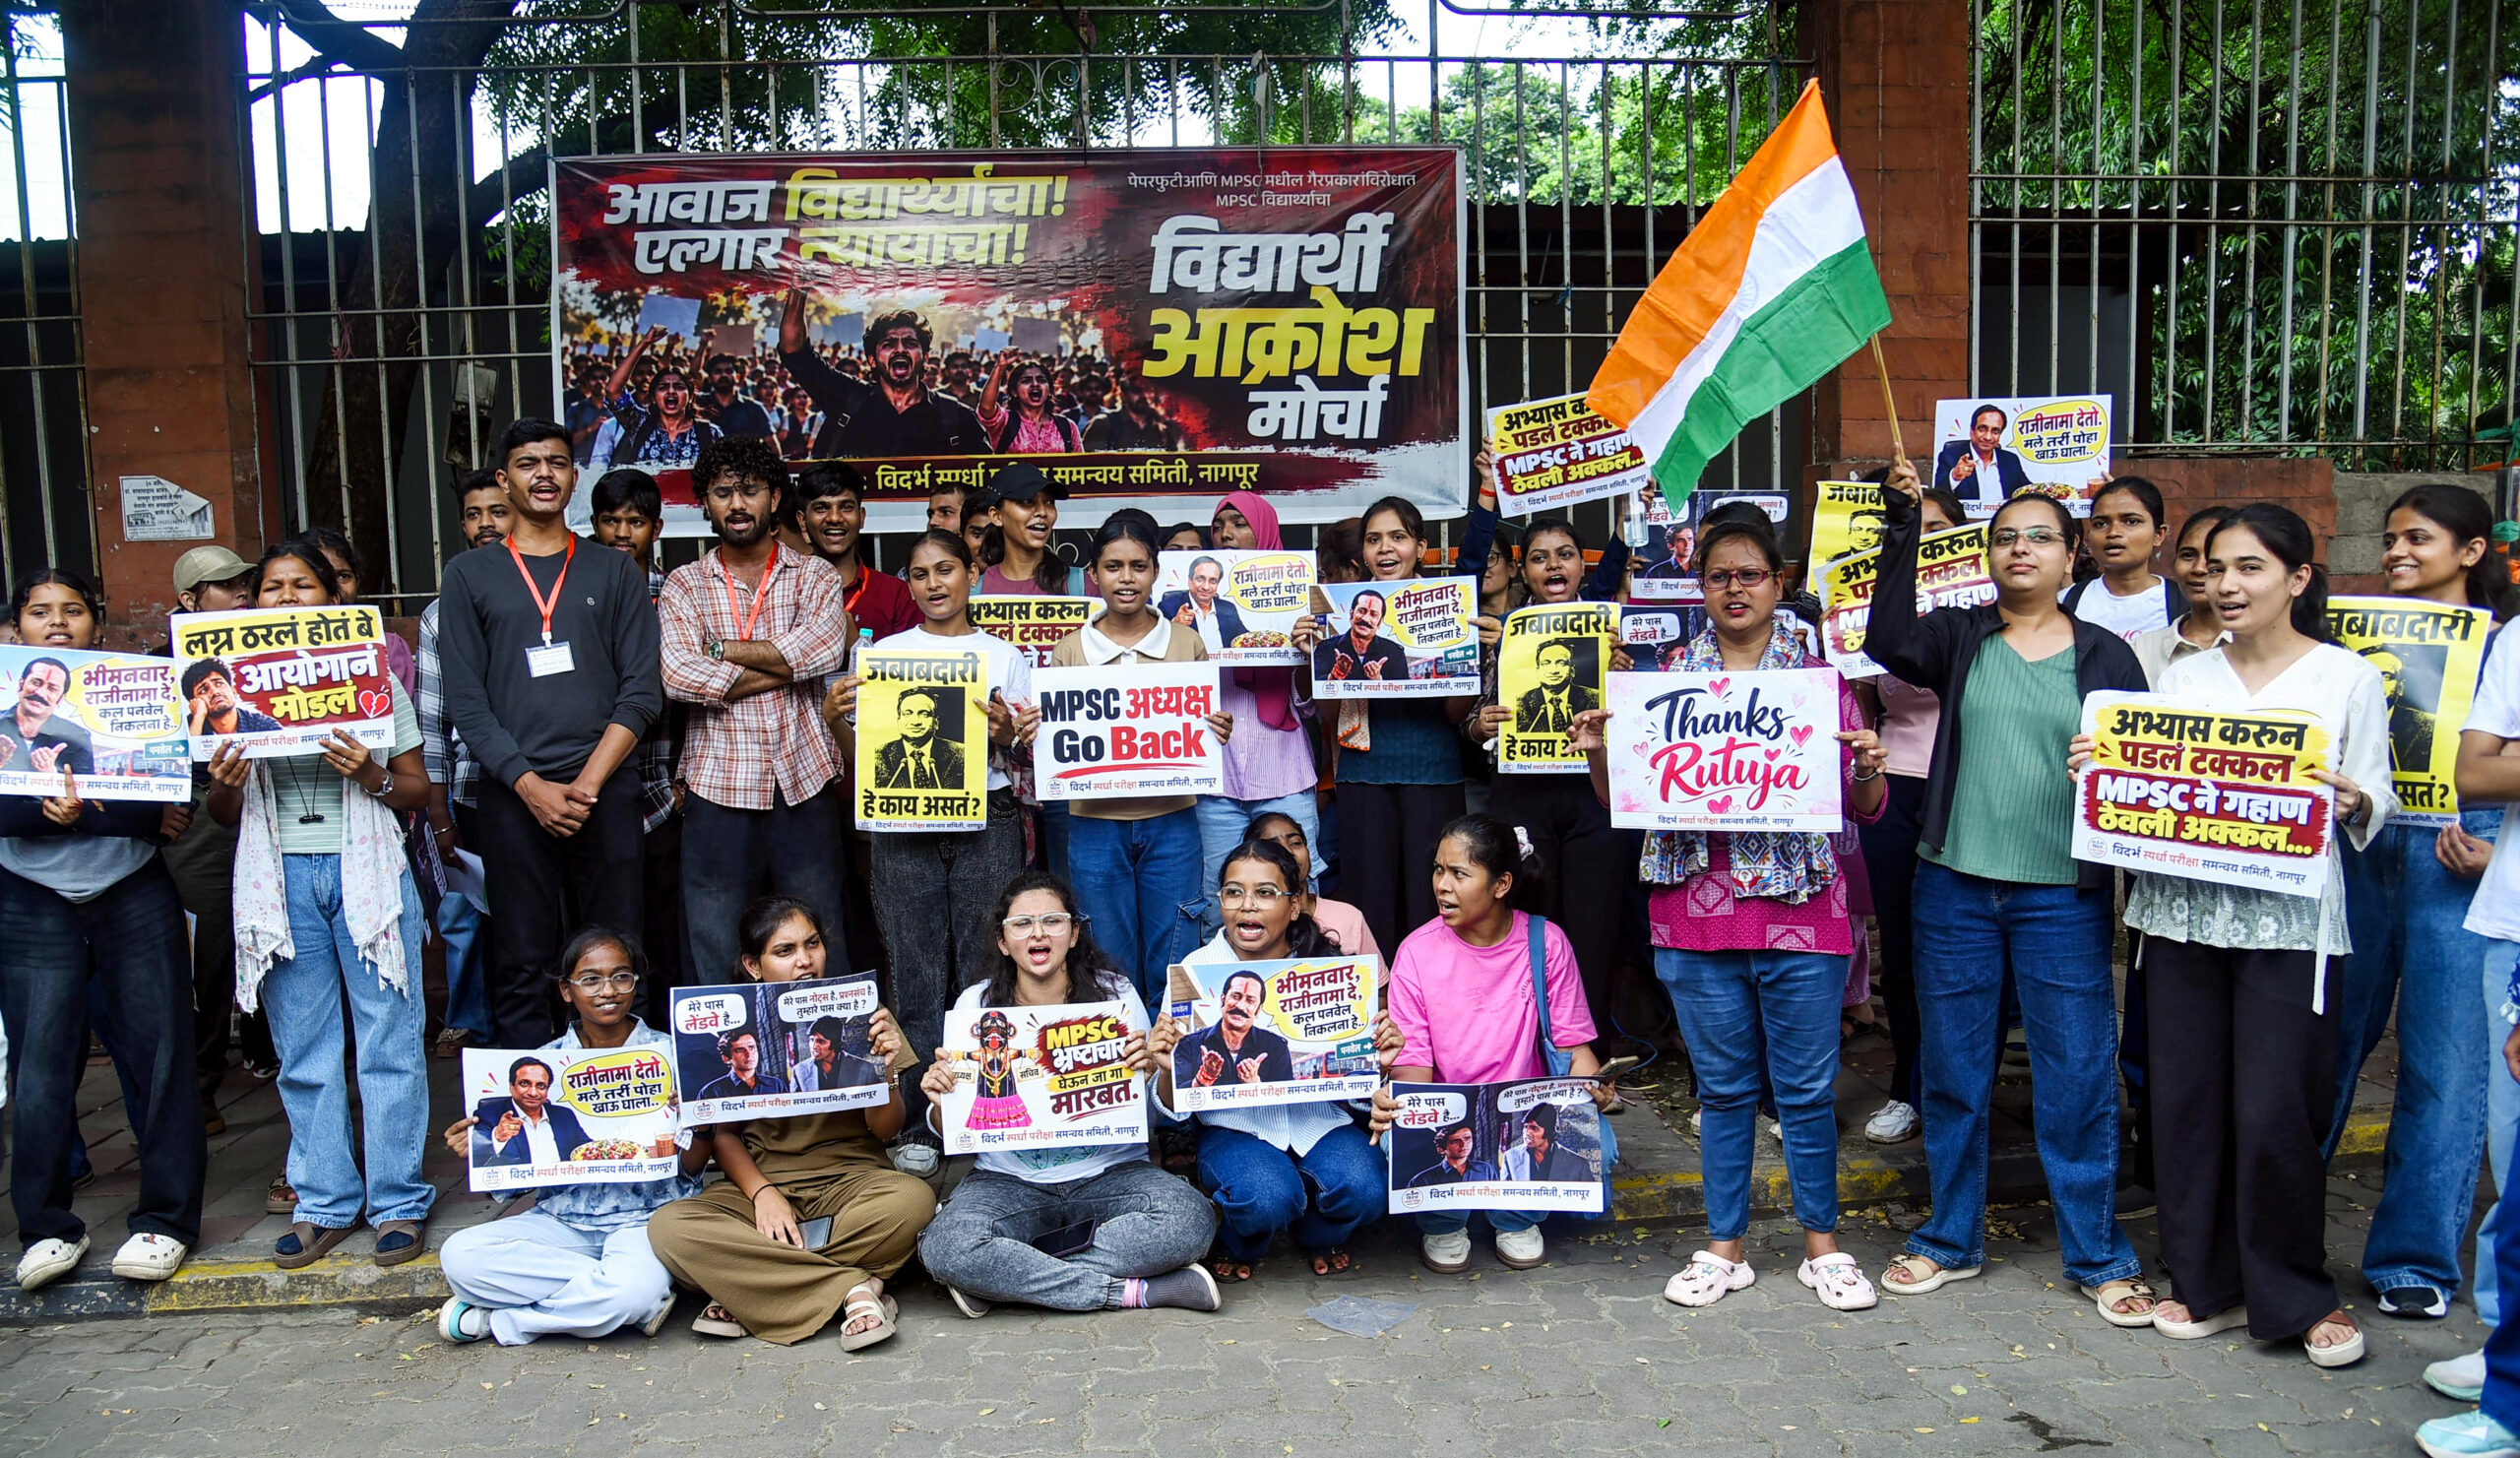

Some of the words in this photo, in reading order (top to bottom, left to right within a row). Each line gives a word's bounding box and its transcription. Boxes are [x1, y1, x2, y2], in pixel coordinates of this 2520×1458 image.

[1221, 175, 1261, 187] MPSC
[1265, 171, 1303, 187] मधील
[603, 180, 777, 223] आवाज
[1217, 195, 1257, 207] MPSC
[634, 228, 789, 274] एल्गार
[799, 223, 1029, 268] न्यायाचा!
[1149, 212, 1395, 292] विद्यार्थी
[1142, 285, 1434, 385] आक्रोश
[1246, 374, 1390, 439] मोर्चा
[1504, 402, 1567, 431] अभ्यास
[2018, 412, 2073, 435] राजीनामा
[2076, 406, 2102, 427] देतो.
[1512, 424, 1556, 448] पडलं
[2024, 435, 2044, 449] मले
[2047, 431, 2070, 448] तर्री
[2074, 430, 2098, 444] पोहा
[1505, 448, 1568, 476] MPSC
[1568, 440, 1585, 462] ने
[2035, 449, 2057, 460] खाऊ
[2060, 446, 2093, 458] घाला..
[876, 463, 931, 490] विदर्भ
[1052, 467, 1123, 485] समन्वय
[1128, 463, 1193, 485] समिती,
[1199, 463, 1259, 488] नागपूर
[1511, 468, 1564, 493] ठेवली
[1567, 451, 1645, 481] अक्कल...
[1921, 528, 1984, 560] करुन
[1234, 564, 1284, 584] राजीनामा
[1287, 560, 1309, 578] देतो.
[1240, 585, 1258, 598] मले
[1260, 582, 1282, 596] तर्री
[1285, 581, 1306, 594] पोहा
[1251, 599, 1272, 608] खाऊ
[1274, 596, 1302, 607] घाला..
[1394, 584, 1462, 609] भीमनवार,
[1035, 602, 1090, 619] करुन
[1397, 603, 1449, 625] राजीनामा
[1452, 600, 1464, 614] दे,
[1510, 604, 1612, 637] जबाबदारी
[1632, 616, 1643, 626] मेरे
[1646, 616, 1662, 626] पास
[186, 627, 233, 656] लग्न
[240, 615, 299, 648] ठरलं
[306, 611, 349, 646] होतं
[356, 609, 373, 638] बे
[1409, 623, 1426, 635] कल
[1428, 617, 1455, 630] पनवेल
[1418, 631, 1454, 645] निकलना
[83, 664, 175, 687] भीमनवार,
[239, 643, 379, 694] आयोगानं
[866, 652, 980, 684] जबाबदारी
[85, 686, 158, 705] राजीनामा
[159, 683, 176, 702] दे,
[270, 679, 357, 722] मोडलं
[1040, 688, 1120, 722] MPSC
[1125, 685, 1213, 719] अध्यक्ष
[98, 707, 123, 719] कल
[127, 703, 163, 717] पनवेल
[1645, 687, 1796, 742] Thanks
[110, 720, 159, 732] निकलना
[2110, 710, 2214, 742] अभ्यास
[2219, 717, 2308, 750] करुन
[1053, 729, 1104, 763] Go
[1110, 723, 1207, 760] Back
[1505, 733, 1517, 761] हे
[1520, 739, 1557, 757] काय
[1649, 736, 1809, 810] Rutuja
[2119, 741, 2184, 772] पडलं
[2189, 747, 2296, 783] टक्कल
[1070, 781, 1092, 792] विदर्भ
[1139, 779, 1165, 788] समन्वय
[1166, 777, 1192, 787] समिती,
[1193, 778, 1217, 788] नागपूर
[862, 789, 876, 818] हे
[879, 795, 918, 815] काय
[2096, 774, 2190, 811] MPSC
[2194, 780, 2221, 814] ने
[2223, 791, 2311, 825] गहाण
[2098, 800, 2178, 840] ठेवली
[2180, 814, 2313, 855] अक्कल...
[2112, 842, 2142, 858] विदर्भ
[2143, 851, 2168, 863] स्पर्धा
[2170, 854, 2199, 867] परीक्षा
[2202, 859, 2238, 874] समन्वय
[2241, 864, 2273, 880] समिती,
[2276, 870, 2306, 884] नागपूर
[1277, 965, 1360, 994] भीमनवार,
[688, 1000, 702, 1011] मेरे
[705, 999, 724, 1010] पास
[1279, 987, 1345, 1013] राजीनामा
[1348, 983, 1362, 1000] दे,
[685, 1012, 719, 1031] लेंडवे
[723, 1012, 740, 1027] है...
[1292, 1010, 1315, 1025] कल
[1318, 1003, 1352, 1019] पनवेल
[1046, 1018, 1118, 1050] MPSC
[1304, 1021, 1349, 1038] निकलना
[1052, 1037, 1128, 1074] भ्रष्टाचार
[1341, 1044, 1361, 1054] पनवेल
[567, 1065, 632, 1090] राजीनामा
[635, 1055, 665, 1080] देतो.
[1020, 1068, 1039, 1078] सचिव
[1058, 1074, 1089, 1090] घेऊन
[1092, 1070, 1106, 1082] जा
[1110, 1067, 1123, 1079] गा
[577, 1088, 600, 1102] मले
[603, 1084, 630, 1101] तर्री
[633, 1082, 662, 1096] पोहा
[593, 1101, 618, 1113] खाऊ
[622, 1097, 659, 1110] घाला..
[1050, 1080, 1139, 1115] मारबत.
[1408, 1097, 1421, 1107] मेरे
[1424, 1098, 1444, 1107] पास
[1403, 1109, 1439, 1125] लेंडवे
[1443, 1109, 1460, 1122] है...
[1429, 1187, 1454, 1198] विदर्भ
[1455, 1186, 1476, 1197] स्पर्धा
[1478, 1186, 1500, 1196] परीक्षा
[1533, 1187, 1560, 1198] समिती,
[1563, 1188, 1590, 1200] नागपूर
